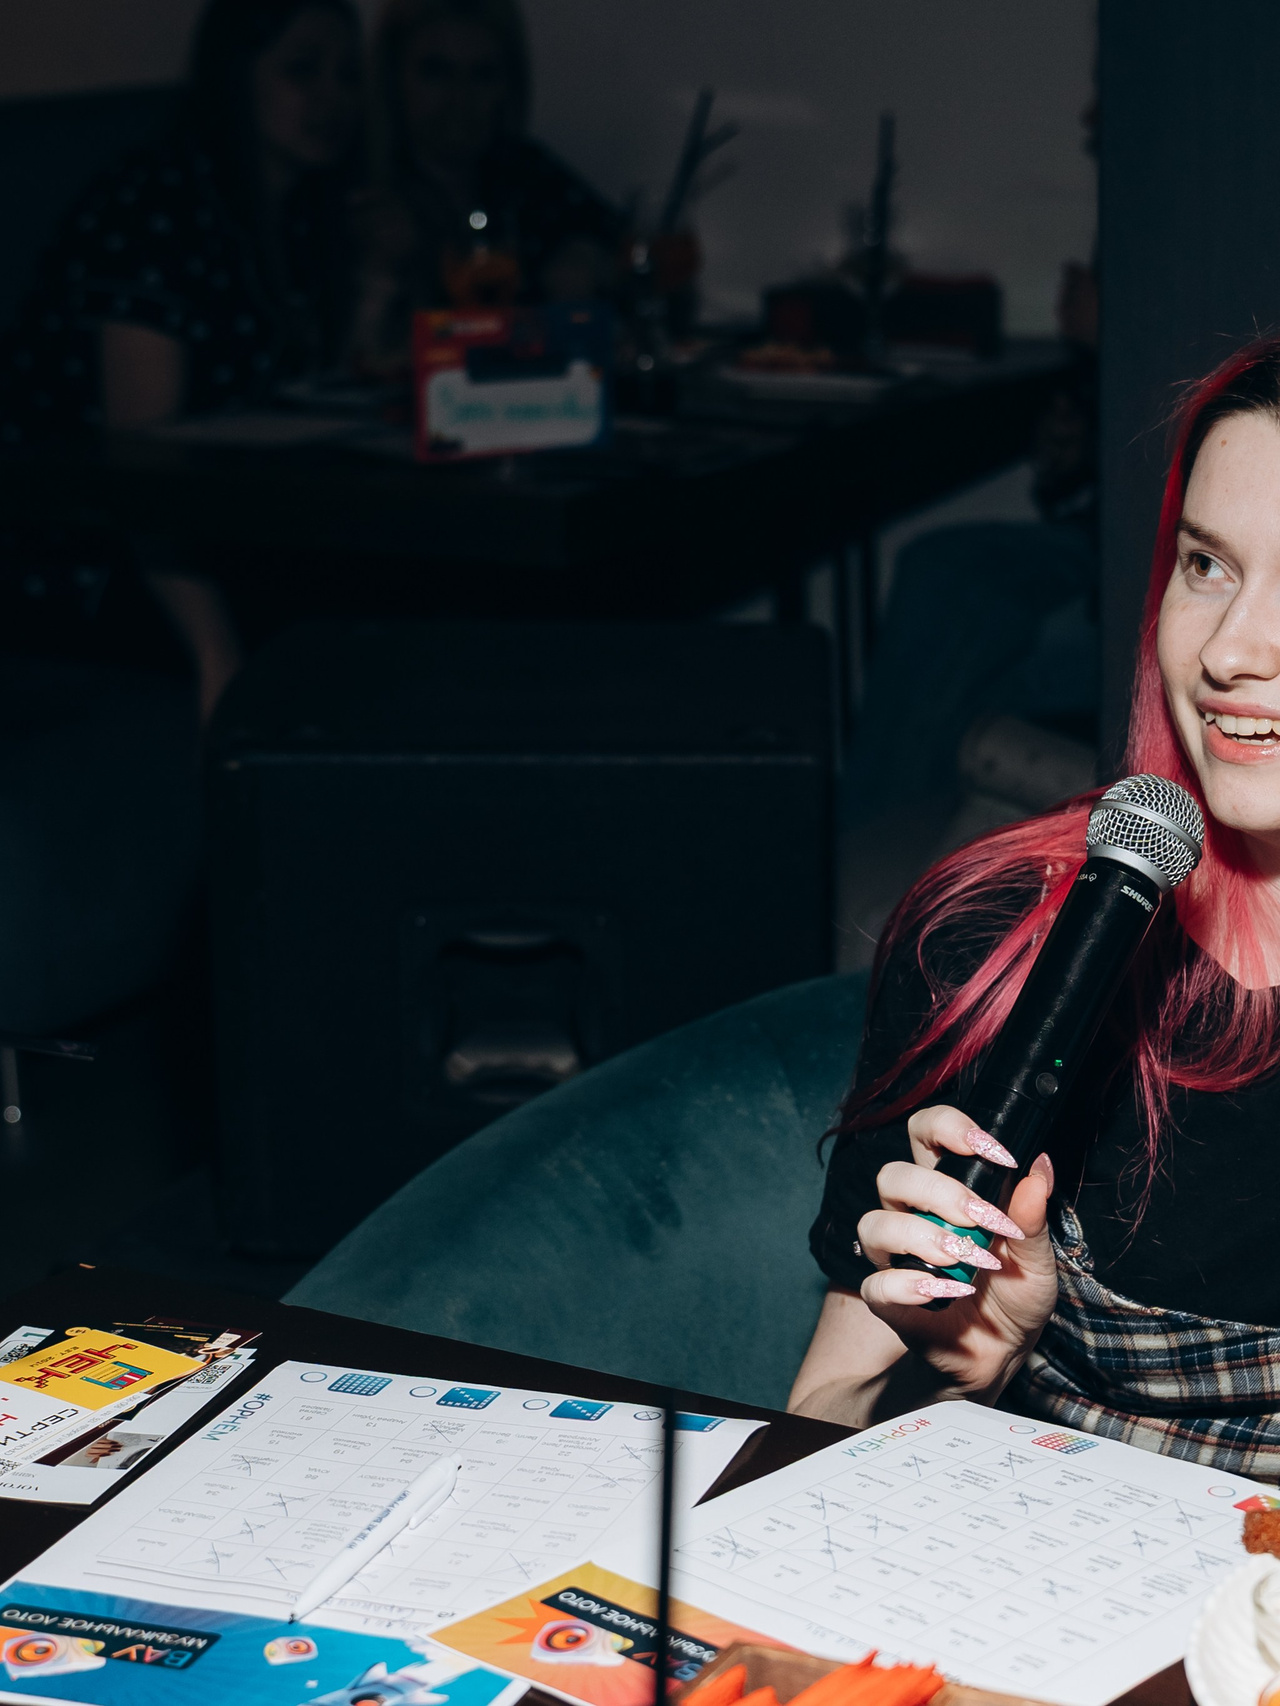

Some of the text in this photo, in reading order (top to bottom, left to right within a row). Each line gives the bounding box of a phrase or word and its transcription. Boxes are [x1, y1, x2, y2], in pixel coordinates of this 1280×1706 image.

[1120, 885, 1154, 912] SHURE
[13, 1343, 139, 1389] ЧЕК
[182, 1511, 216, 1520] CREAM
[2, 1608, 209, 1650] МУЗЫКАЛЬНОЕ ЛОТО
[559, 1590, 717, 1664] УЗЫКЛЬНОЕ ЛОТО
[111, 1643, 194, 1668] ВАУ
